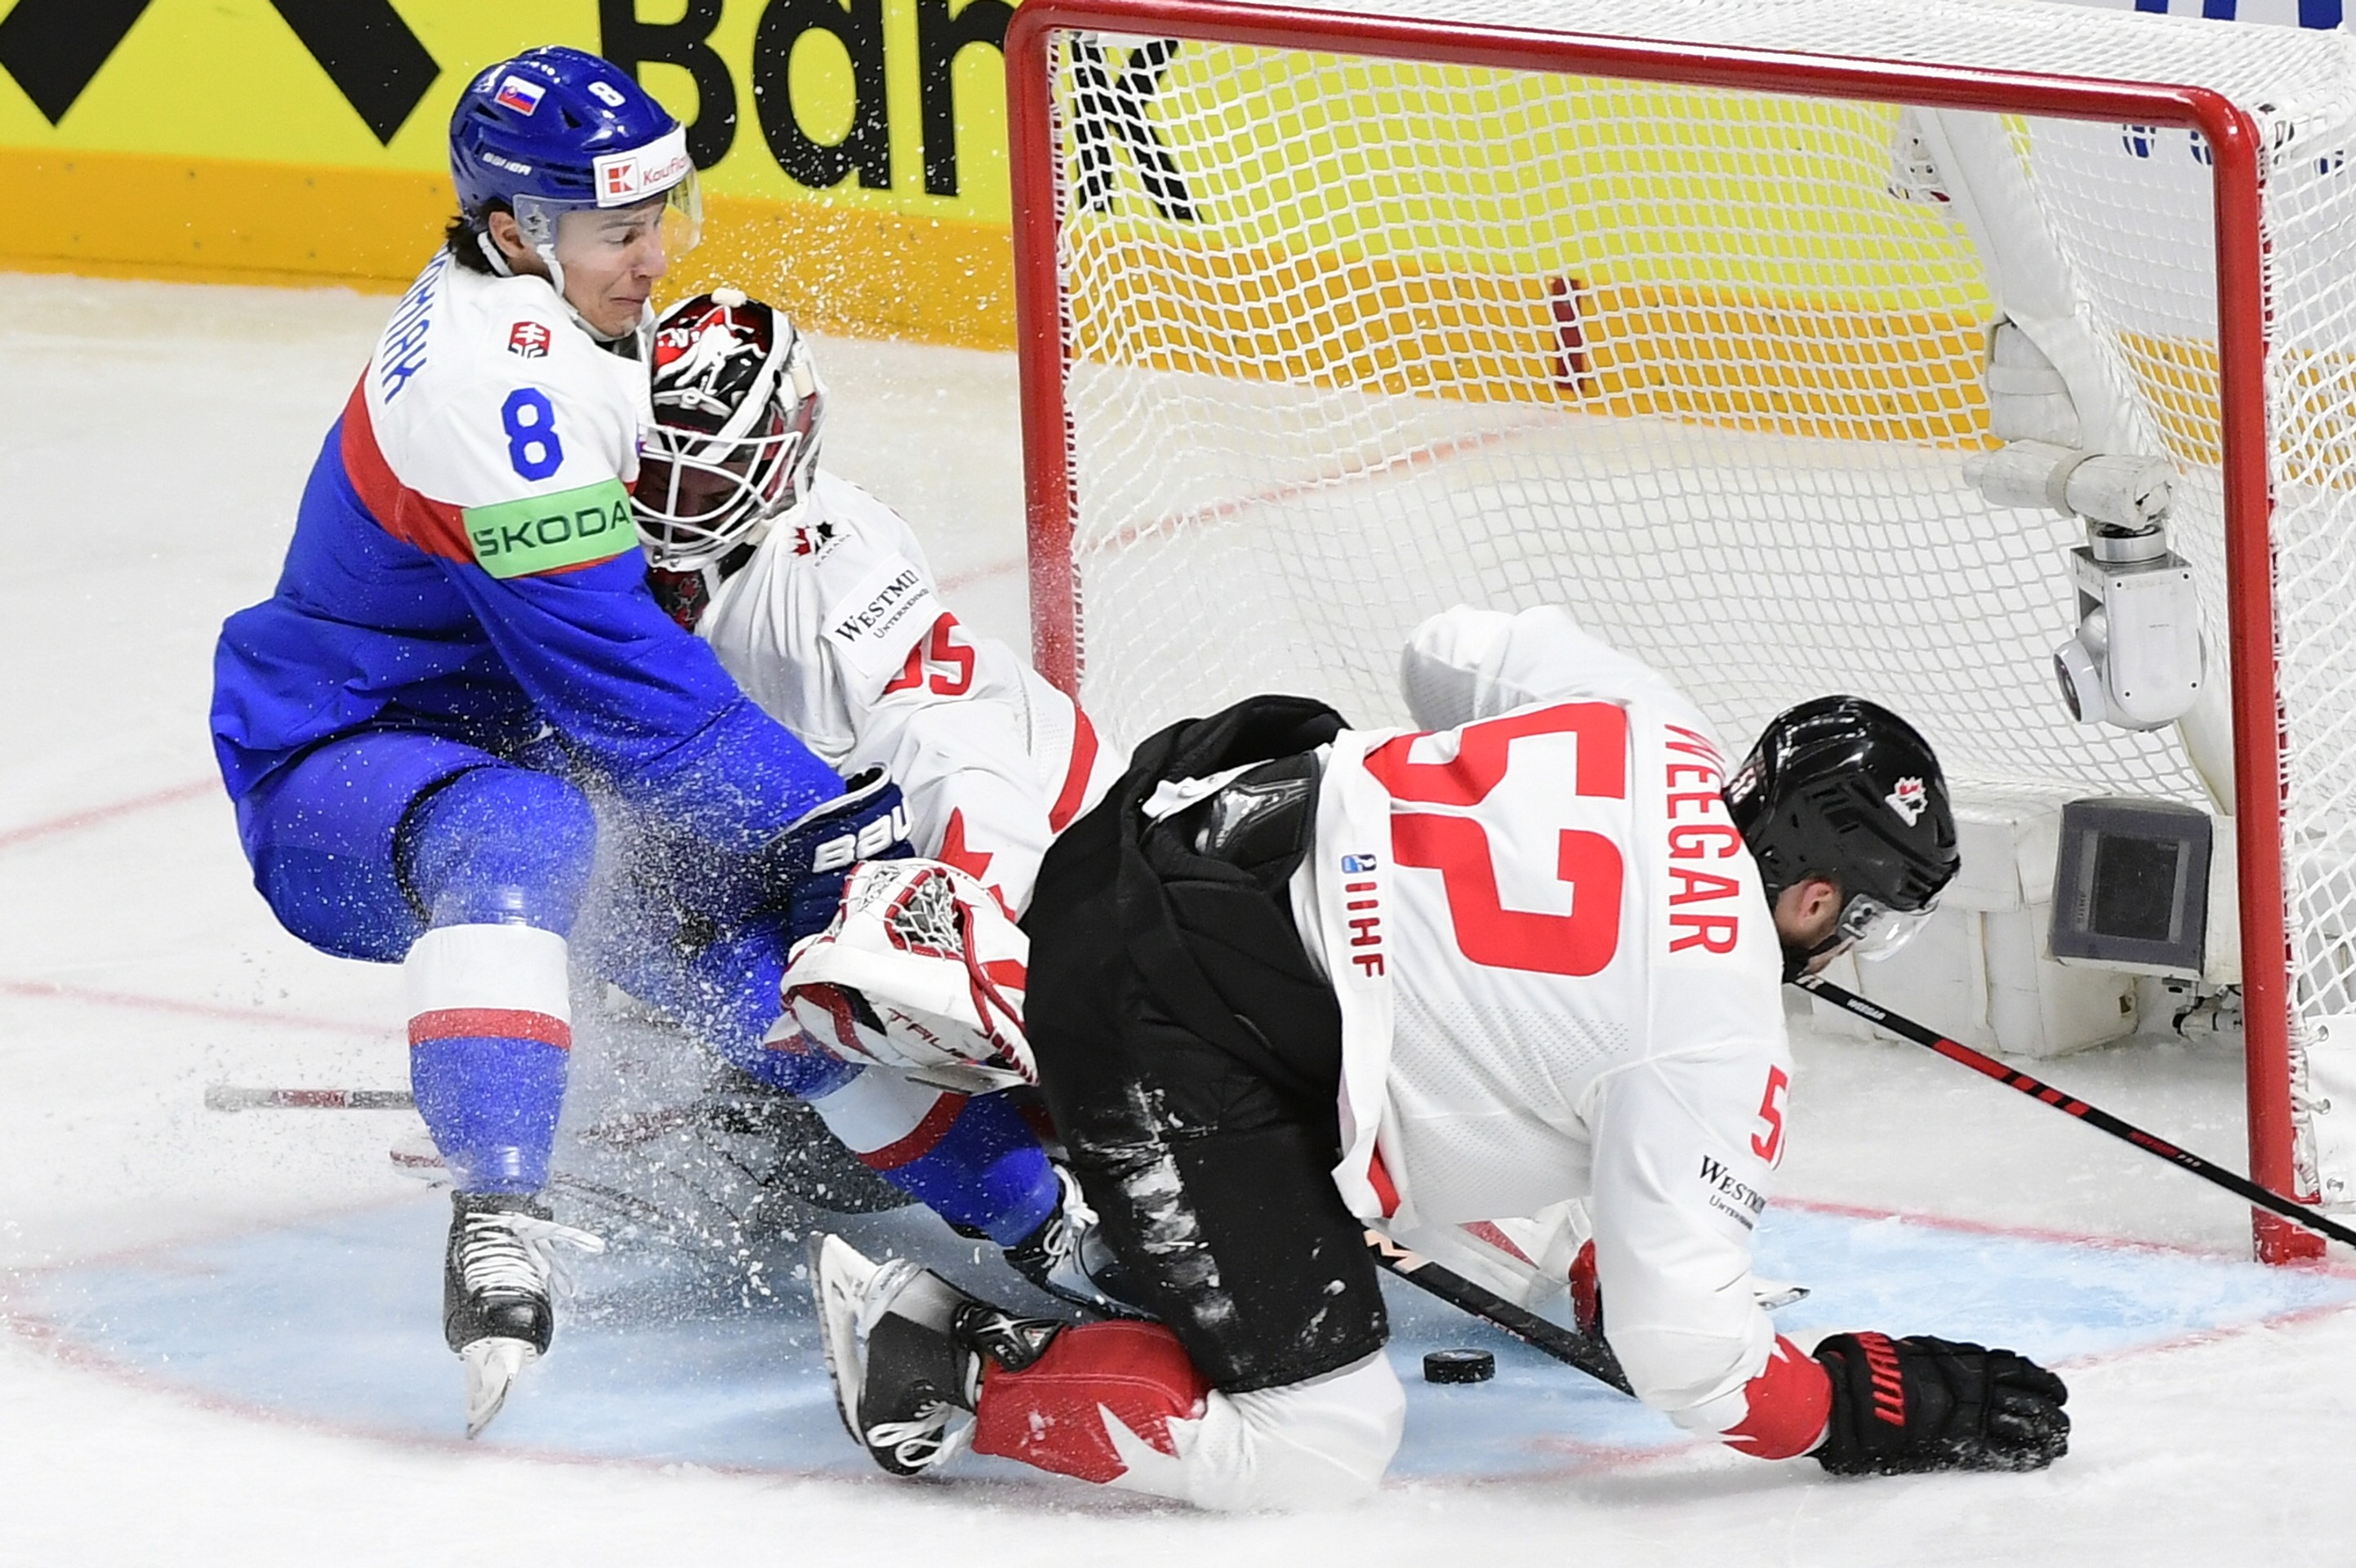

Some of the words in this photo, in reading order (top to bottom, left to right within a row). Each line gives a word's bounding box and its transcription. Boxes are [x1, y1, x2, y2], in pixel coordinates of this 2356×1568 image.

[587, 81, 626, 107] 8
[501, 387, 564, 482] 8
[1362, 701, 1628, 978] 52
[1663, 723, 1744, 955] WEEGAR
[1344, 881, 1385, 978] IIHF
[1749, 1064, 1788, 1171] 5
